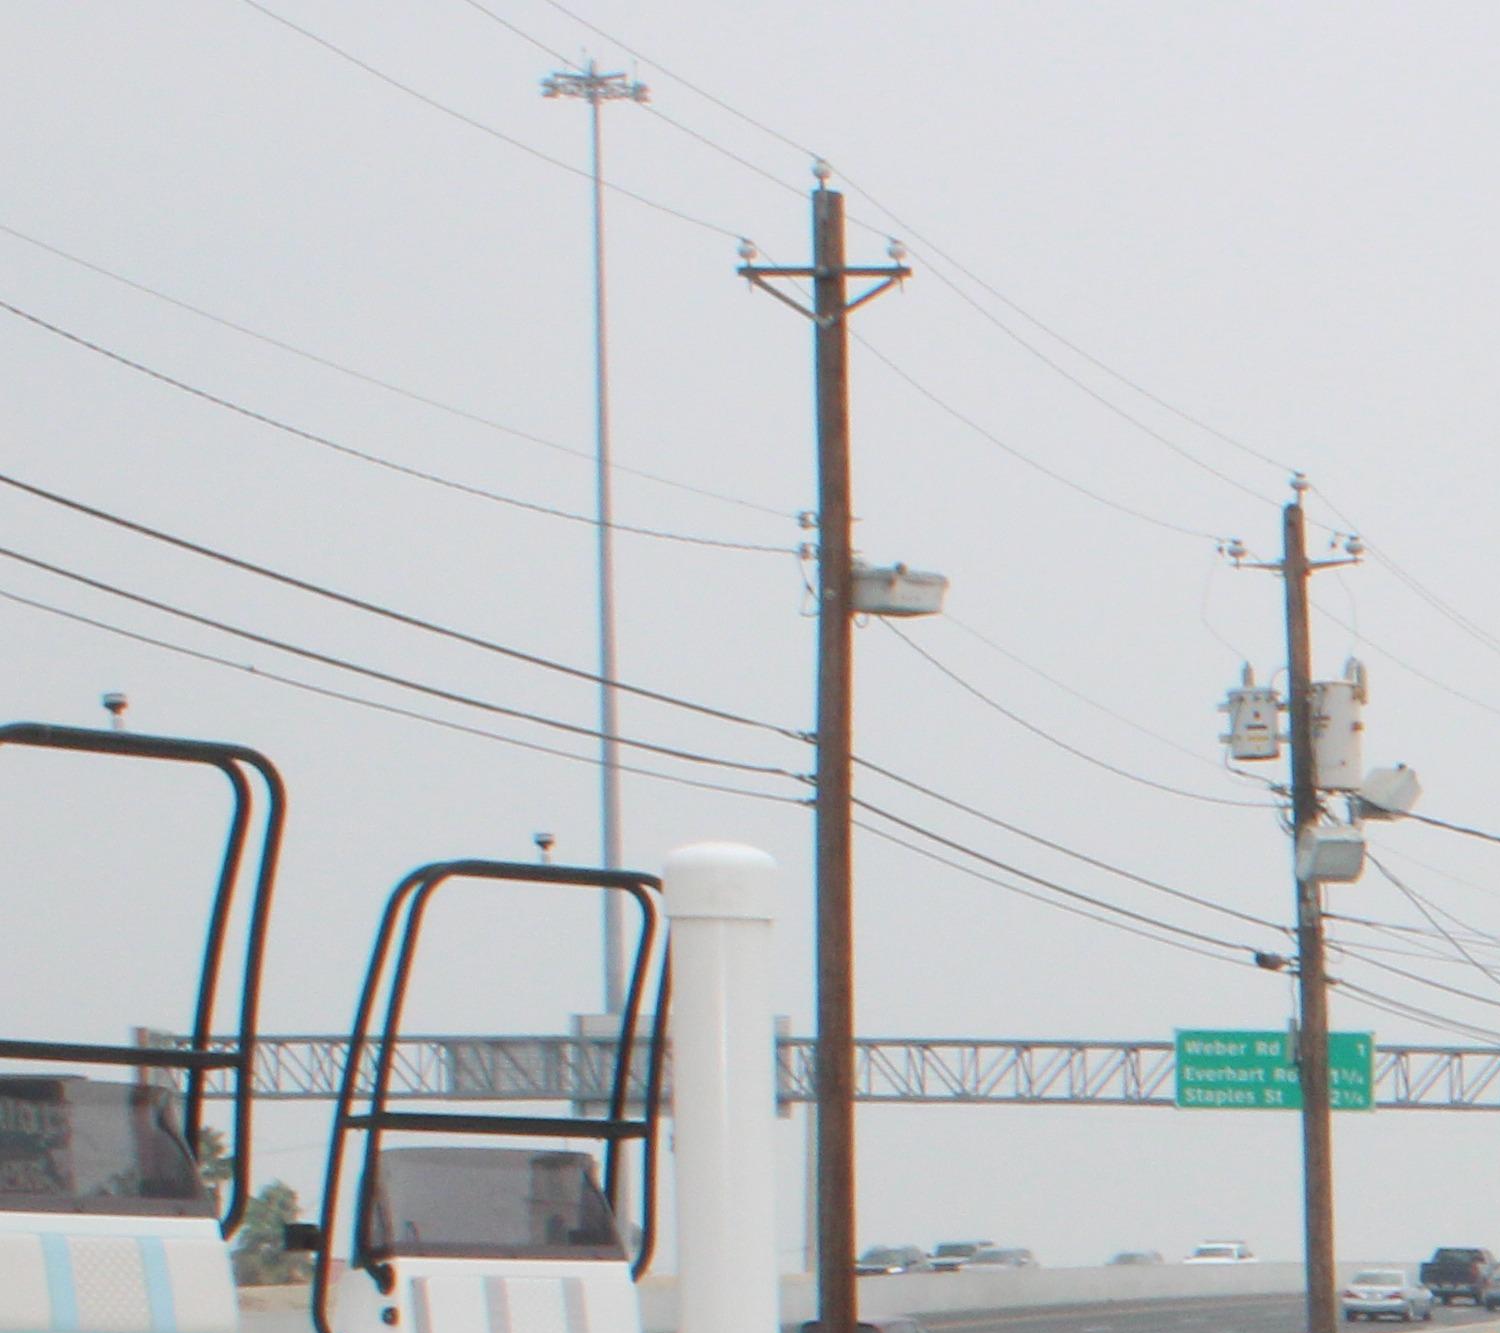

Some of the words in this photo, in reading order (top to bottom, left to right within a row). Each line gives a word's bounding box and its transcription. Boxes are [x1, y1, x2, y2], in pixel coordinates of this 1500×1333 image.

[1184, 1039, 1247, 1056] Weber
[1254, 1040, 1280, 1057] Rd
[1183, 1065, 1265, 1082] Everhart
